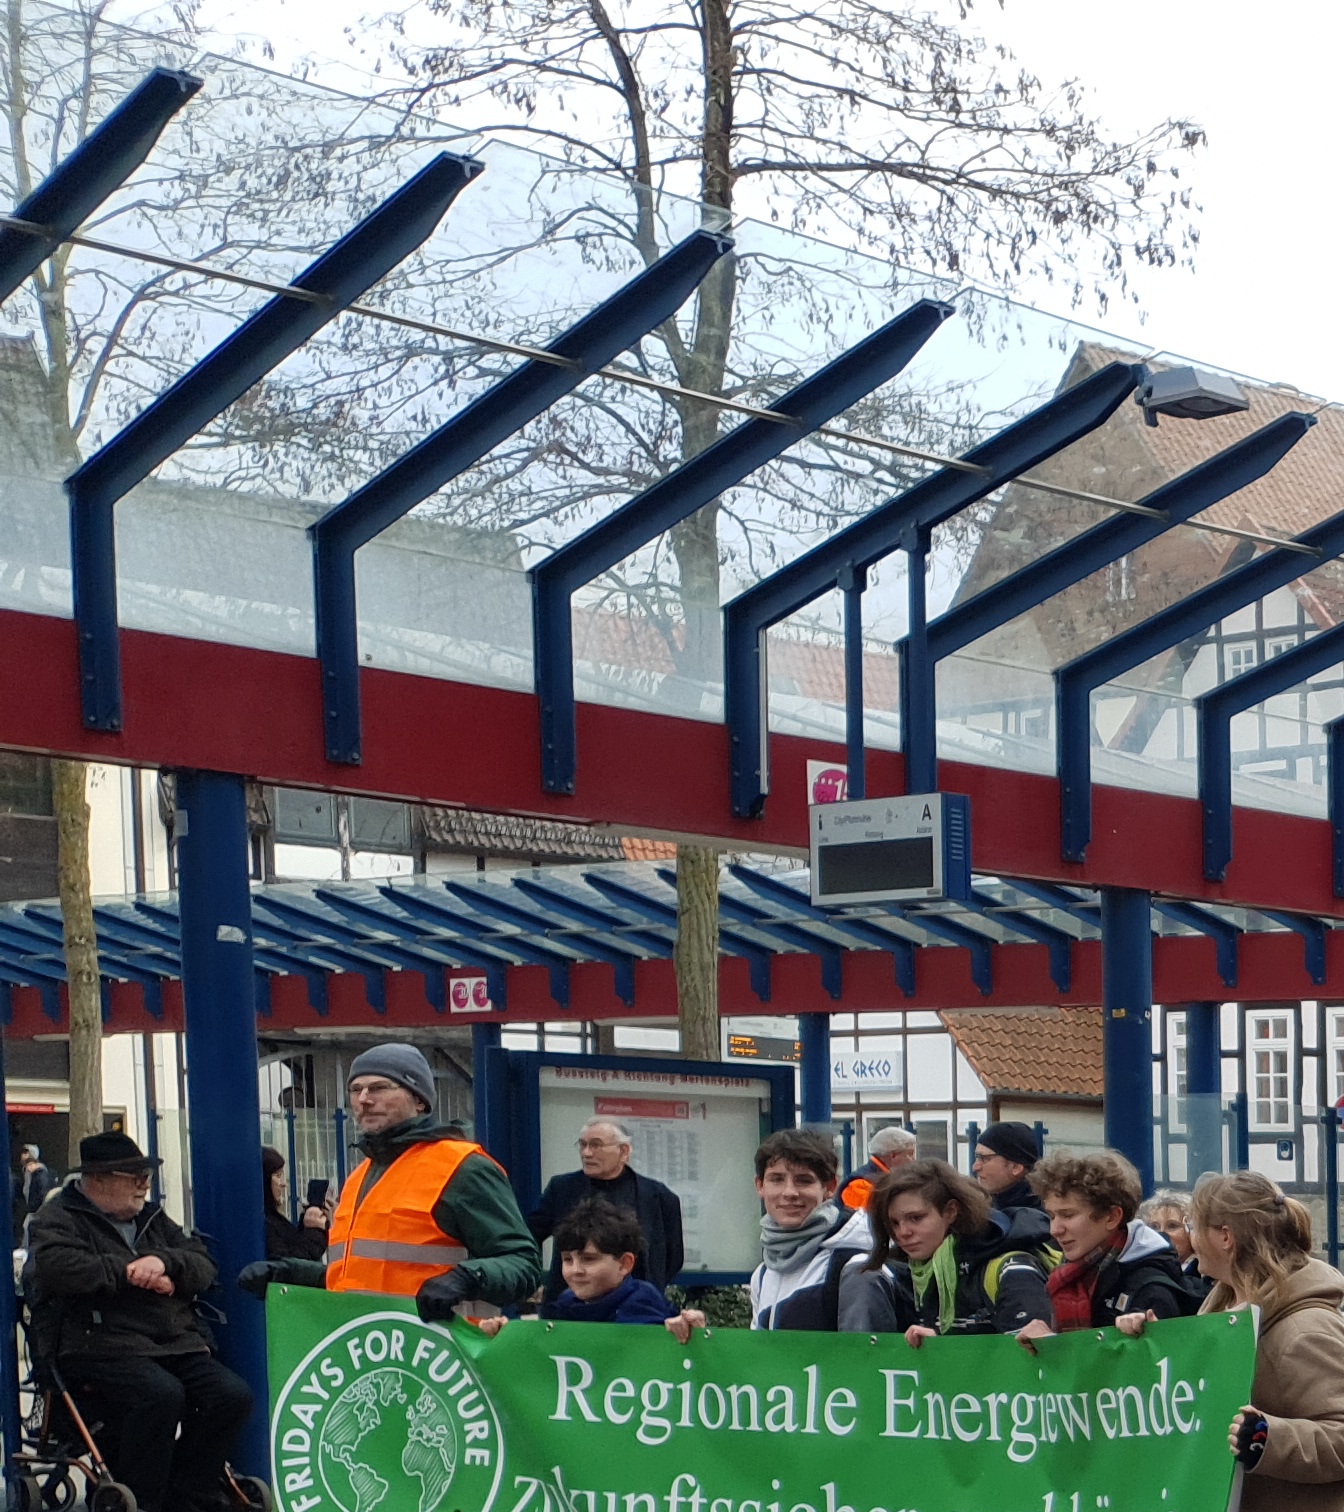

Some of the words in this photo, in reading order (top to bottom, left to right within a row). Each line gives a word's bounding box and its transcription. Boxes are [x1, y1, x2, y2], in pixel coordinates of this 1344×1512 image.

[921, 803, 932, 821] A
[833, 1061, 848, 1079] EL
[852, 1059, 892, 1079] GRECO
[346, 1329, 405, 1370] FOR
[412, 1338, 491, 1467] FUTURE
[548, 1355, 858, 1445] Regionale
[878, 1357, 1205, 1463] Energiewende:
